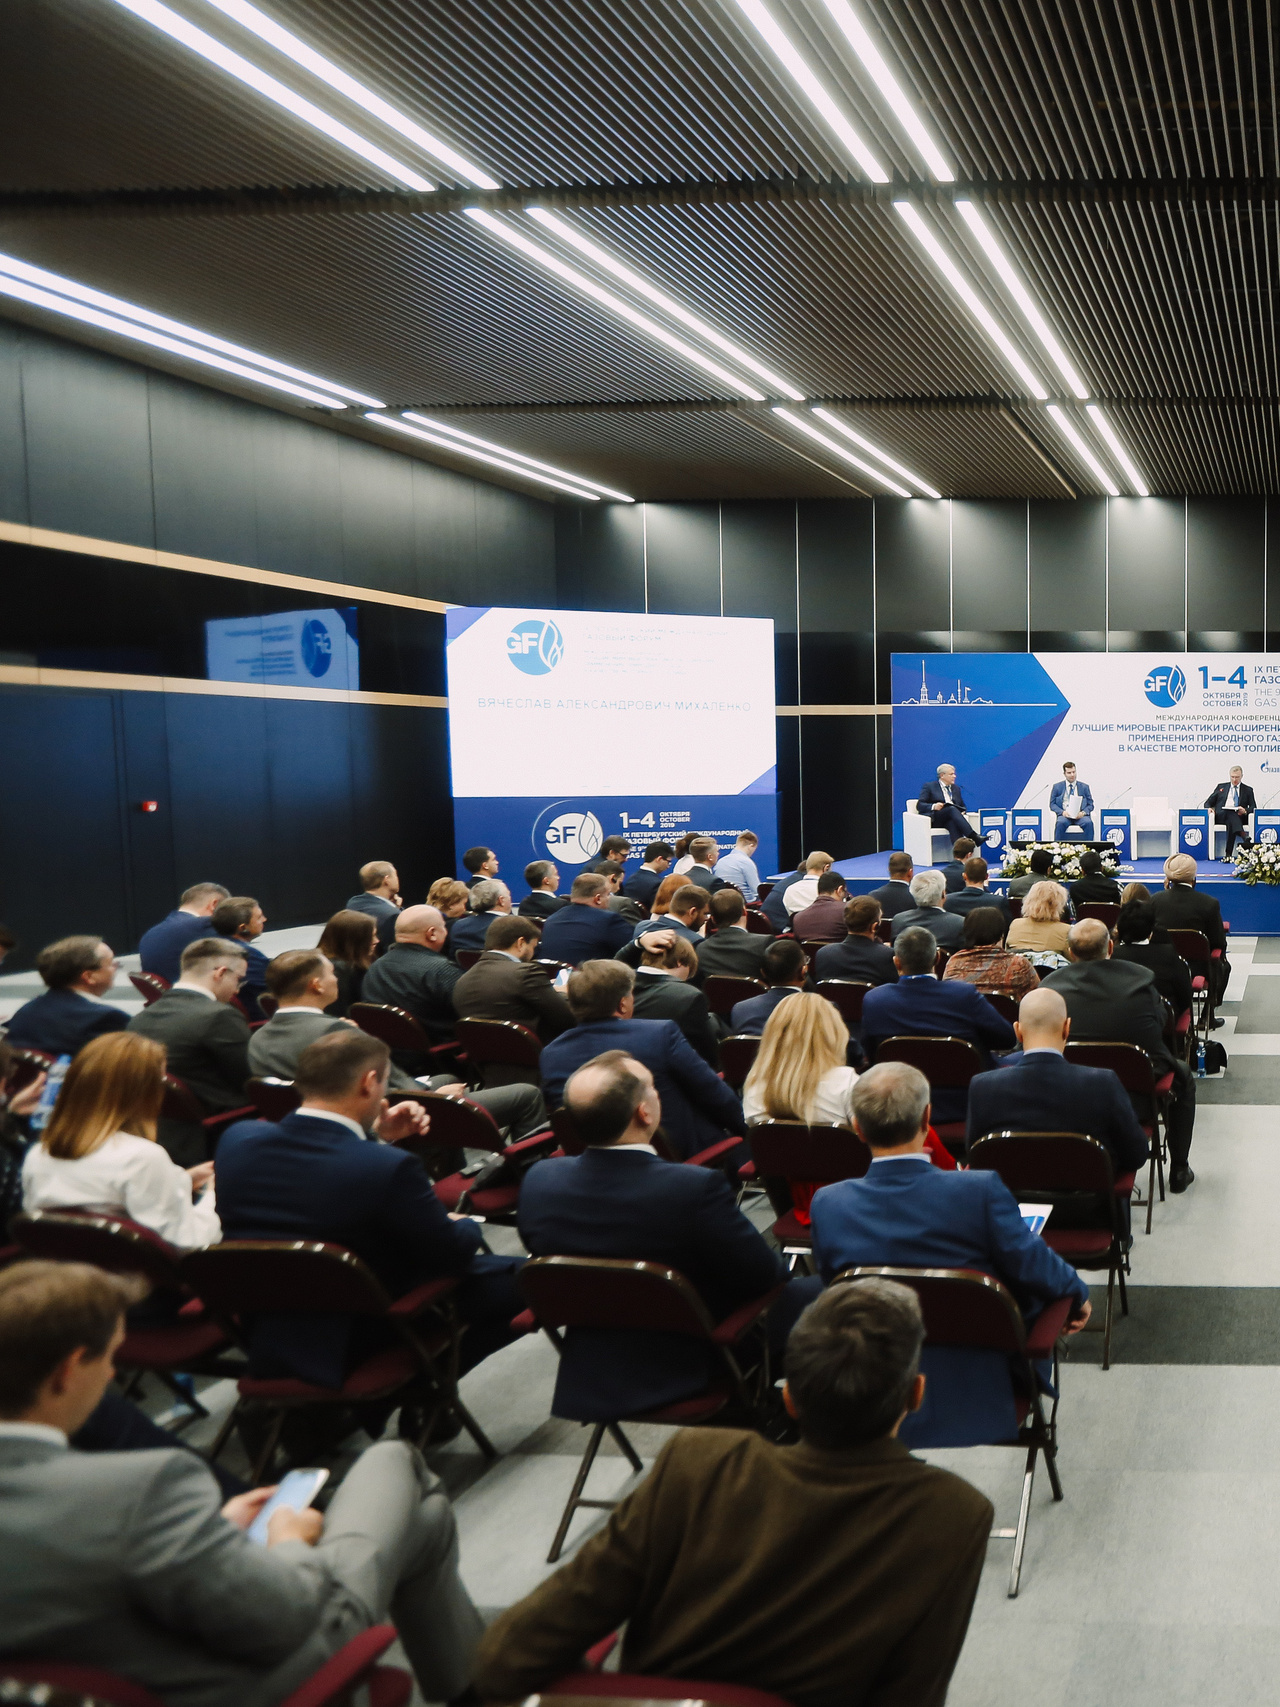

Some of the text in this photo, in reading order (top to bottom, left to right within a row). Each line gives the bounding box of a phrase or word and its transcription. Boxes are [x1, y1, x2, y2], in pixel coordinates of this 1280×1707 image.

[1144, 676, 1167, 692] GF
[1255, 688, 1272, 696] THE
[478, 697, 751, 712] ВЯЧЕСЛАВ АЛЕКСАНДРОВИЧ МИХАЛЕНКО
[1255, 699, 1277, 707] GAS
[1156, 714, 1230, 722] МЕЖДУНАРОДНАЯ
[1071, 724, 1114, 732] ЛУЧШИЕ
[1117, 724, 1166, 732] МИРОВЫЕ
[1169, 724, 1220, 732] ПРАКТИКИ
[1197, 735, 1264, 743] ПРИРОДНОГО
